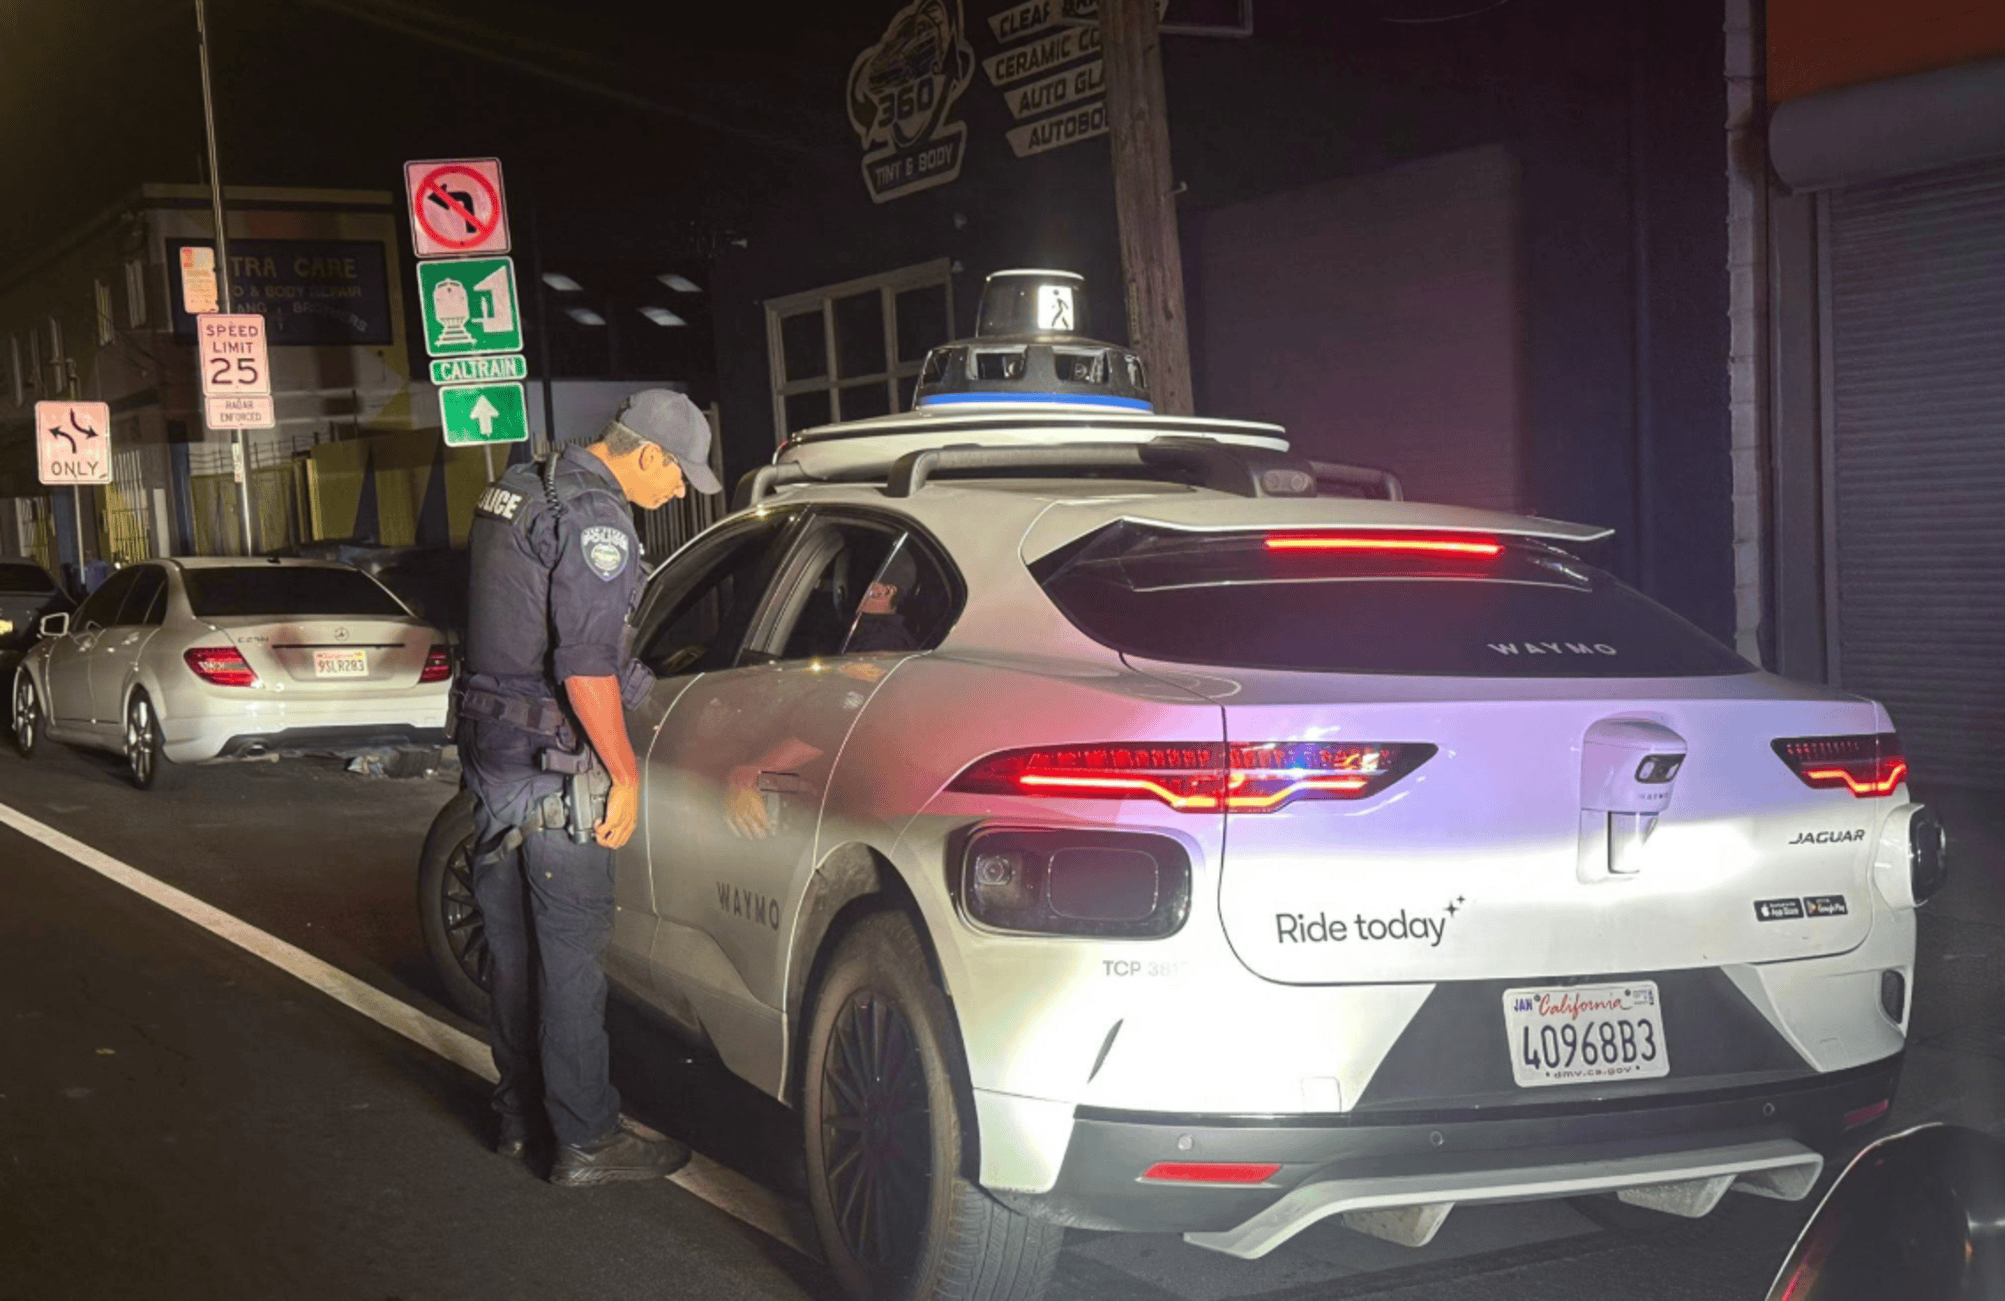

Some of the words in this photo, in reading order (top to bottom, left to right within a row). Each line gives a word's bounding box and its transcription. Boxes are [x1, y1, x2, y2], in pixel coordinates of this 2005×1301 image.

[995, 36, 1071, 81] CERAMIC
[877, 75, 935, 129] 360
[1018, 78, 1067, 114] AUTO
[875, 160, 902, 187] TINT
[905, 157, 914, 176] &
[918, 143, 954, 172] BODY
[293, 256, 357, 278] CARE
[265, 285, 304, 298] BODY
[206, 324, 258, 337] SPEED
[213, 341, 253, 354] LIMIT
[210, 357, 259, 385] 25
[440, 358, 517, 380] CALTRAIN
[225, 400, 253, 410] RADAR
[220, 412, 262, 423] ENFORCED
[51, 461, 99, 477] ONLY
[1487, 642, 1617, 656] WAYMO
[1788, 828, 1866, 844] JAGUAR
[716, 881, 779, 931] WAYMO
[1275, 911, 1347, 944] Ride
[1353, 908, 1446, 947] today
[1102, 960, 1141, 977] TCP
[1514, 998, 1533, 1012] JAN
[1538, 992, 1632, 1021] California
[1523, 1018, 1656, 1069] 40968B3
[1554, 1066, 1632, 1079] dmv.ca.gov
